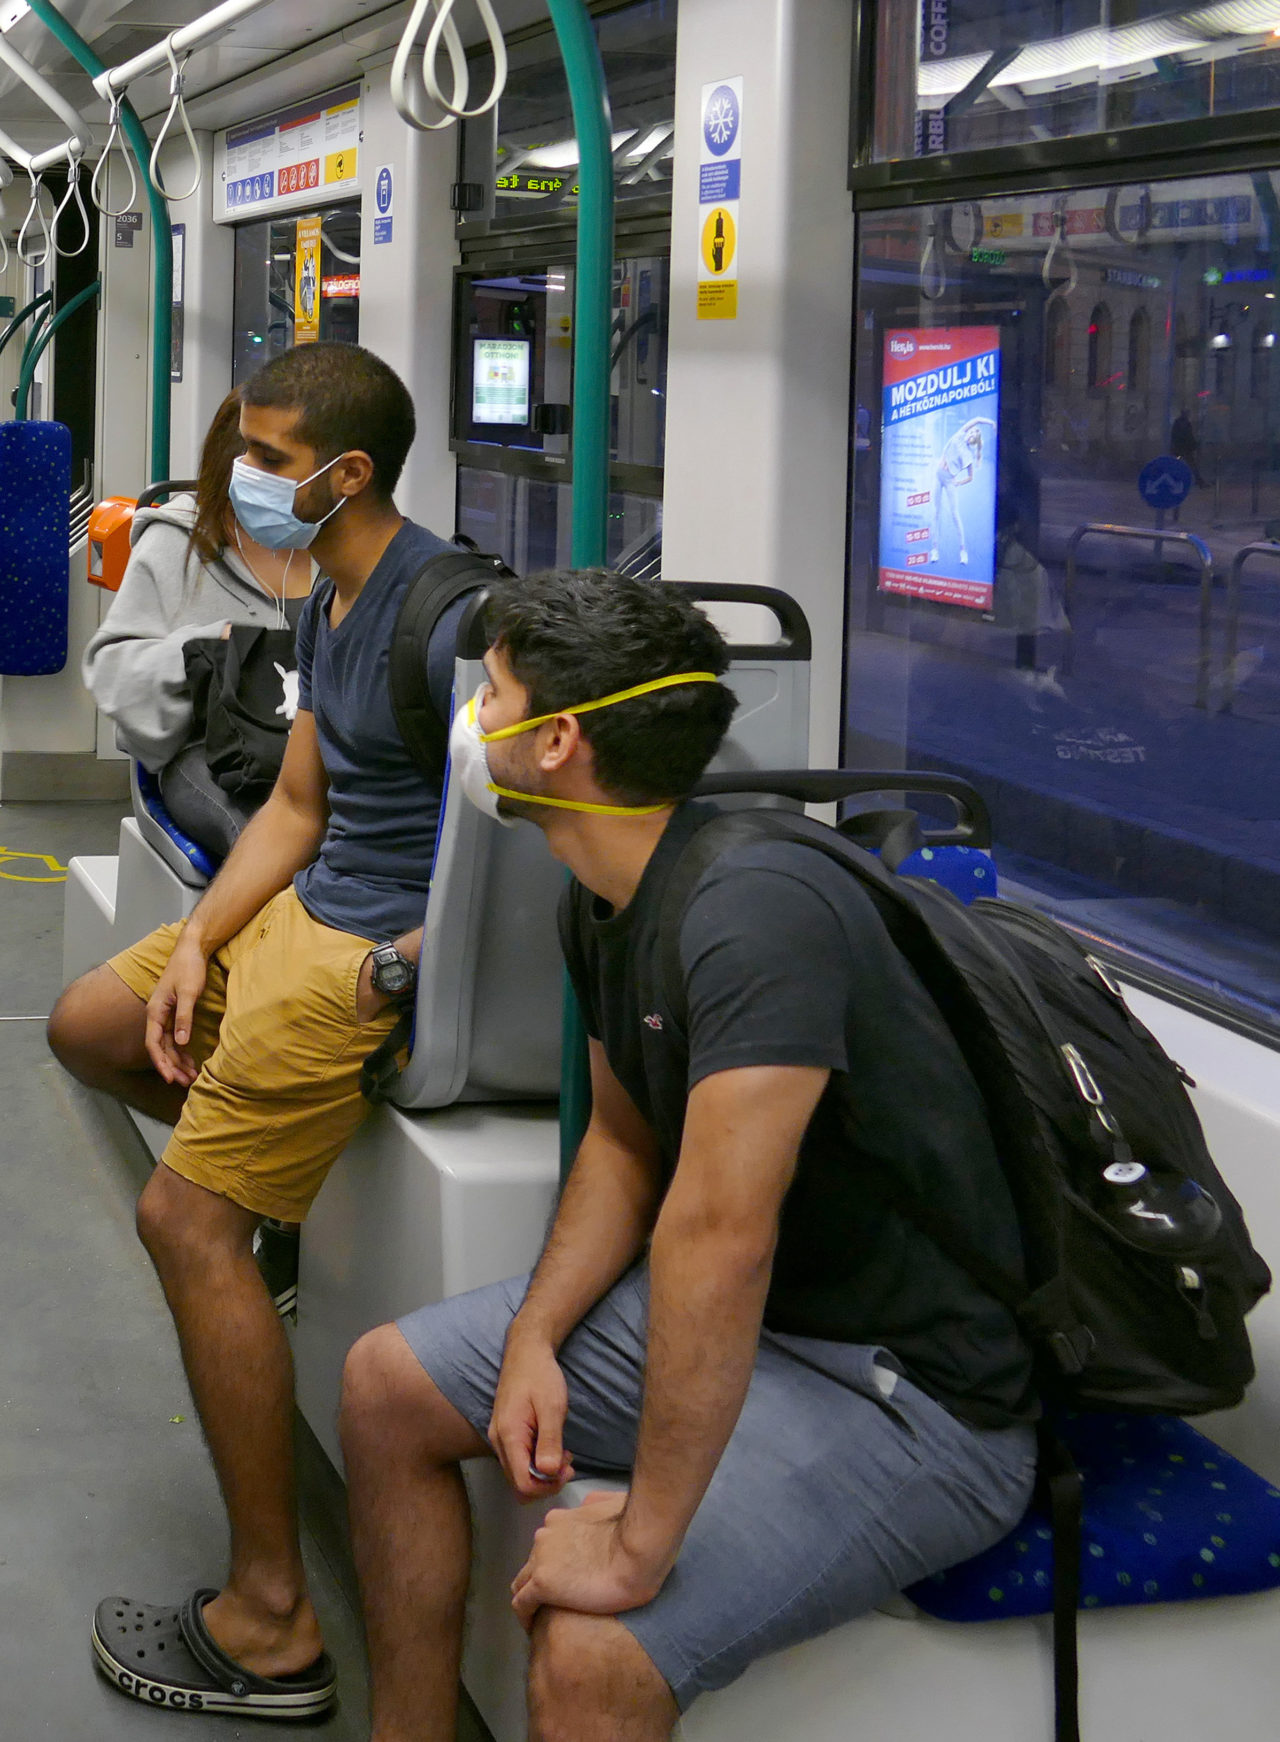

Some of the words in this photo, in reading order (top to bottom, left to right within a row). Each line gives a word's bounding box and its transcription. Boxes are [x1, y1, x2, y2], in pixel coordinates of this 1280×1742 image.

[116, 215, 138, 223] 2036
[116, 232, 123, 241] 5
[891, 361, 972, 407] MOZDULJ
[976, 354, 995, 380] KI
[891, 409, 899, 421] A
[119, 1672, 203, 1708] crocs
